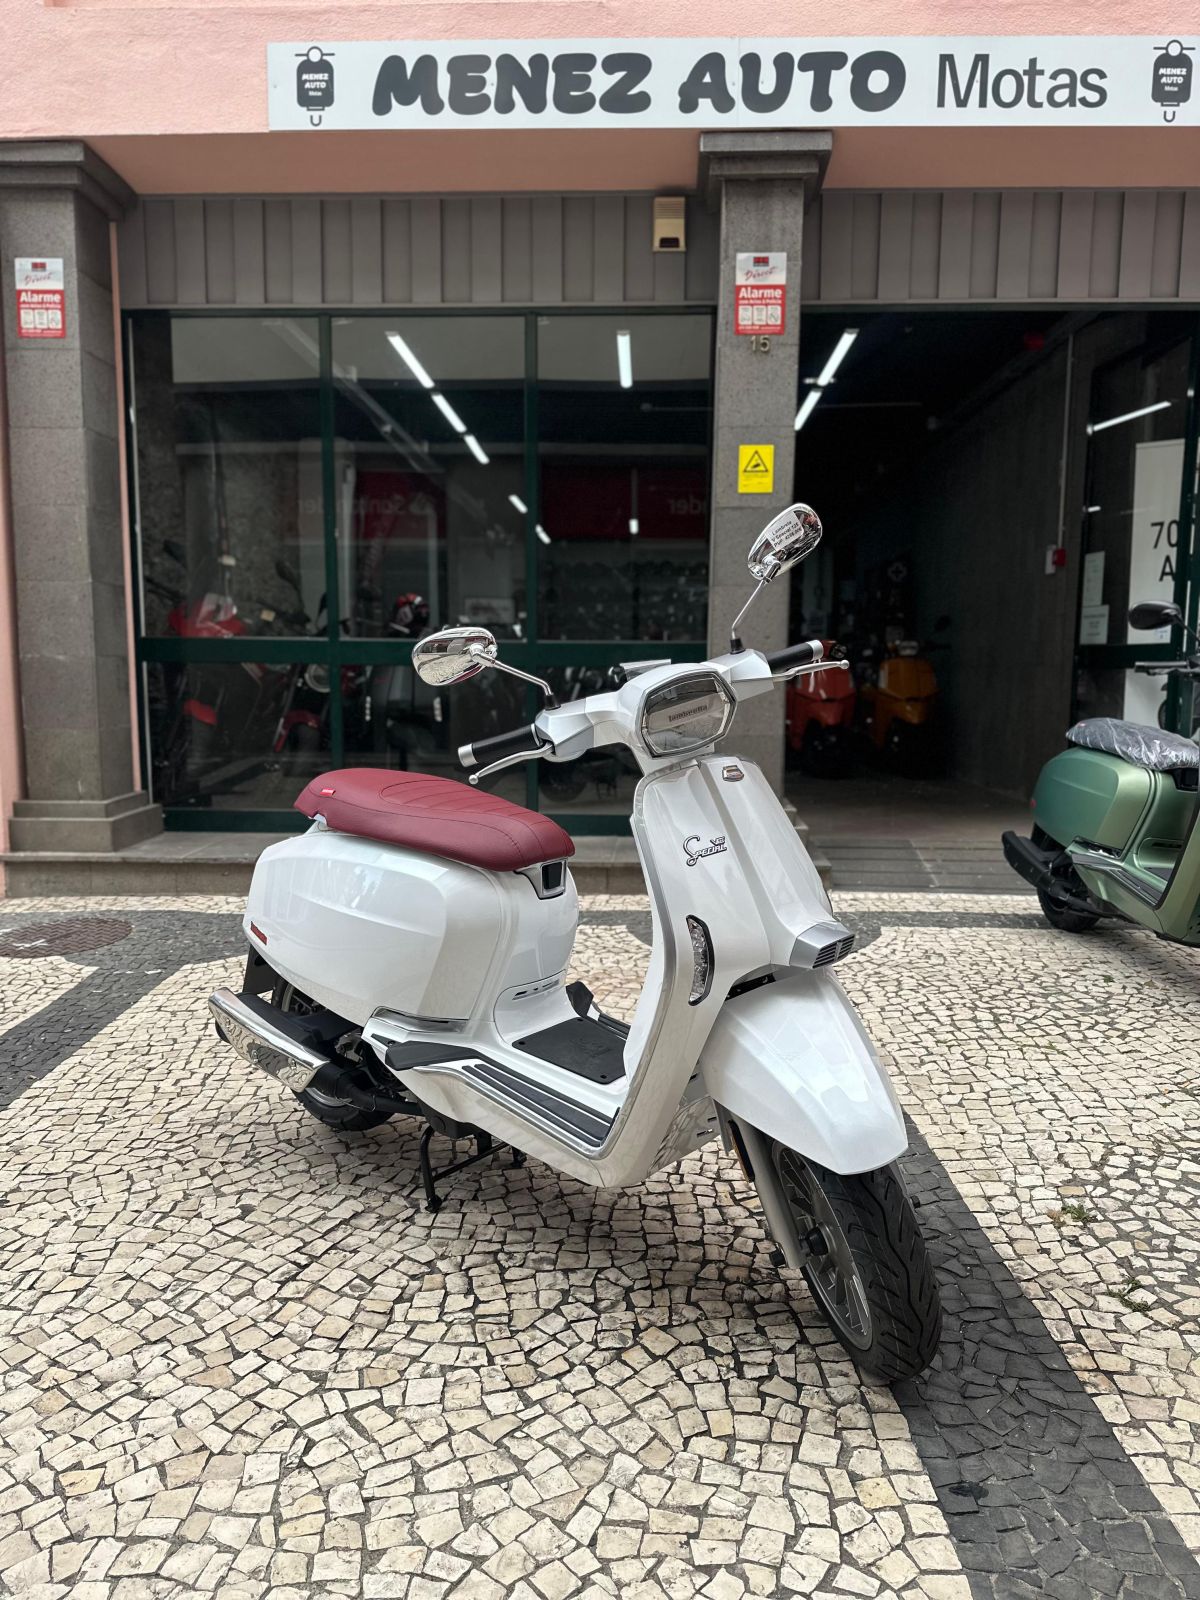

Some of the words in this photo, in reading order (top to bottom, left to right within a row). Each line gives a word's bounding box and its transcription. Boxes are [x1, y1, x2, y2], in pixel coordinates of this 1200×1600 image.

[372, 52, 652, 116] MENEZ
[678, 50, 906, 114] AUTO
[937, 53, 1107, 110] Motas
[20, 291, 61, 303] Alarme
[739, 287, 782, 298] Alarme
[750, 335, 770, 352] 15
[1150, 520, 1179, 550] 70
